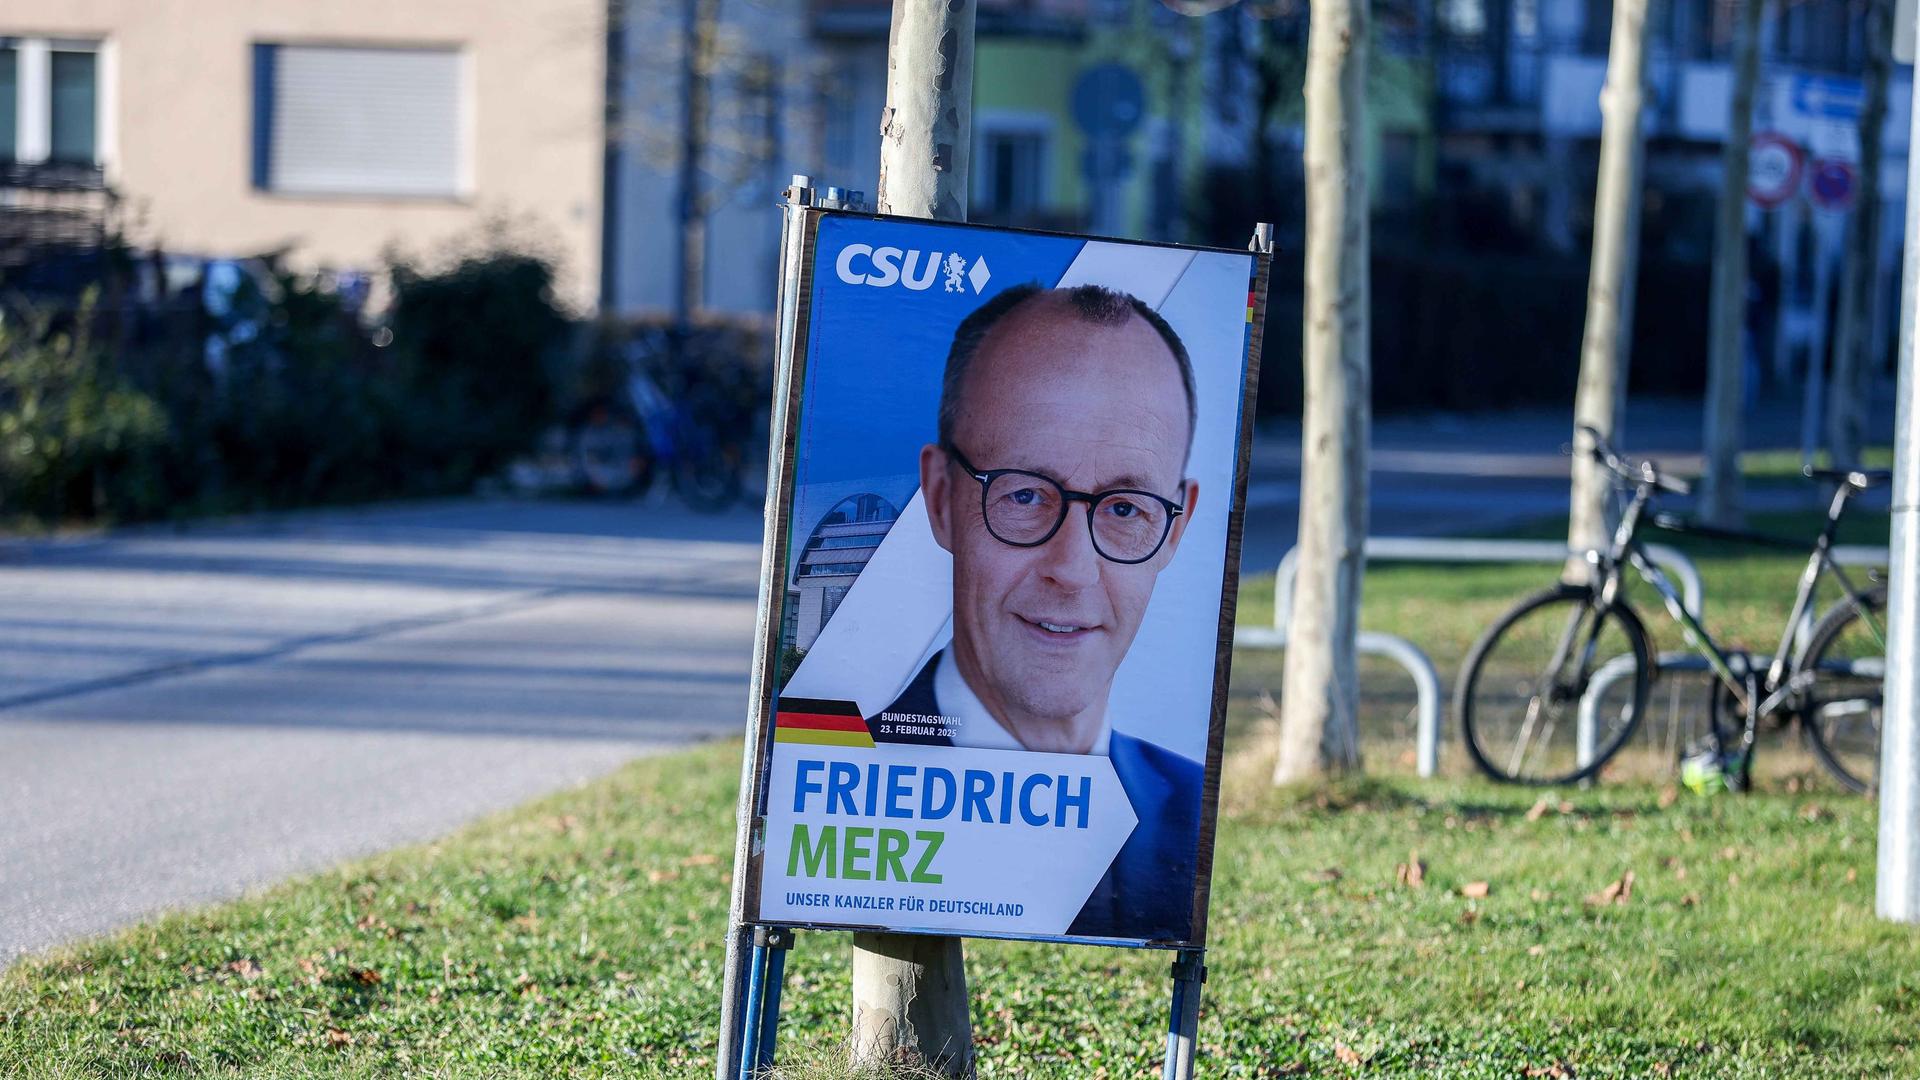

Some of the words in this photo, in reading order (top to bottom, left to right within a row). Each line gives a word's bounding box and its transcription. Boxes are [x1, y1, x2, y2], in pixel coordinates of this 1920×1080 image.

[835, 243, 943, 291] CSU
[880, 725, 893, 734] 23.
[896, 725, 935, 736] FEBRUAR
[937, 728, 957, 737] 2025
[881, 712, 962, 726] BUNDESTAGSWAHL
[792, 759, 1092, 829] FRIEDRICH
[786, 823, 945, 885] MERZ
[786, 892, 830, 908] UNSER
[834, 894, 895, 910] KANZLER
[898, 894, 924, 912] FÜR
[929, 899, 1024, 916] DEUTSCHLAND
